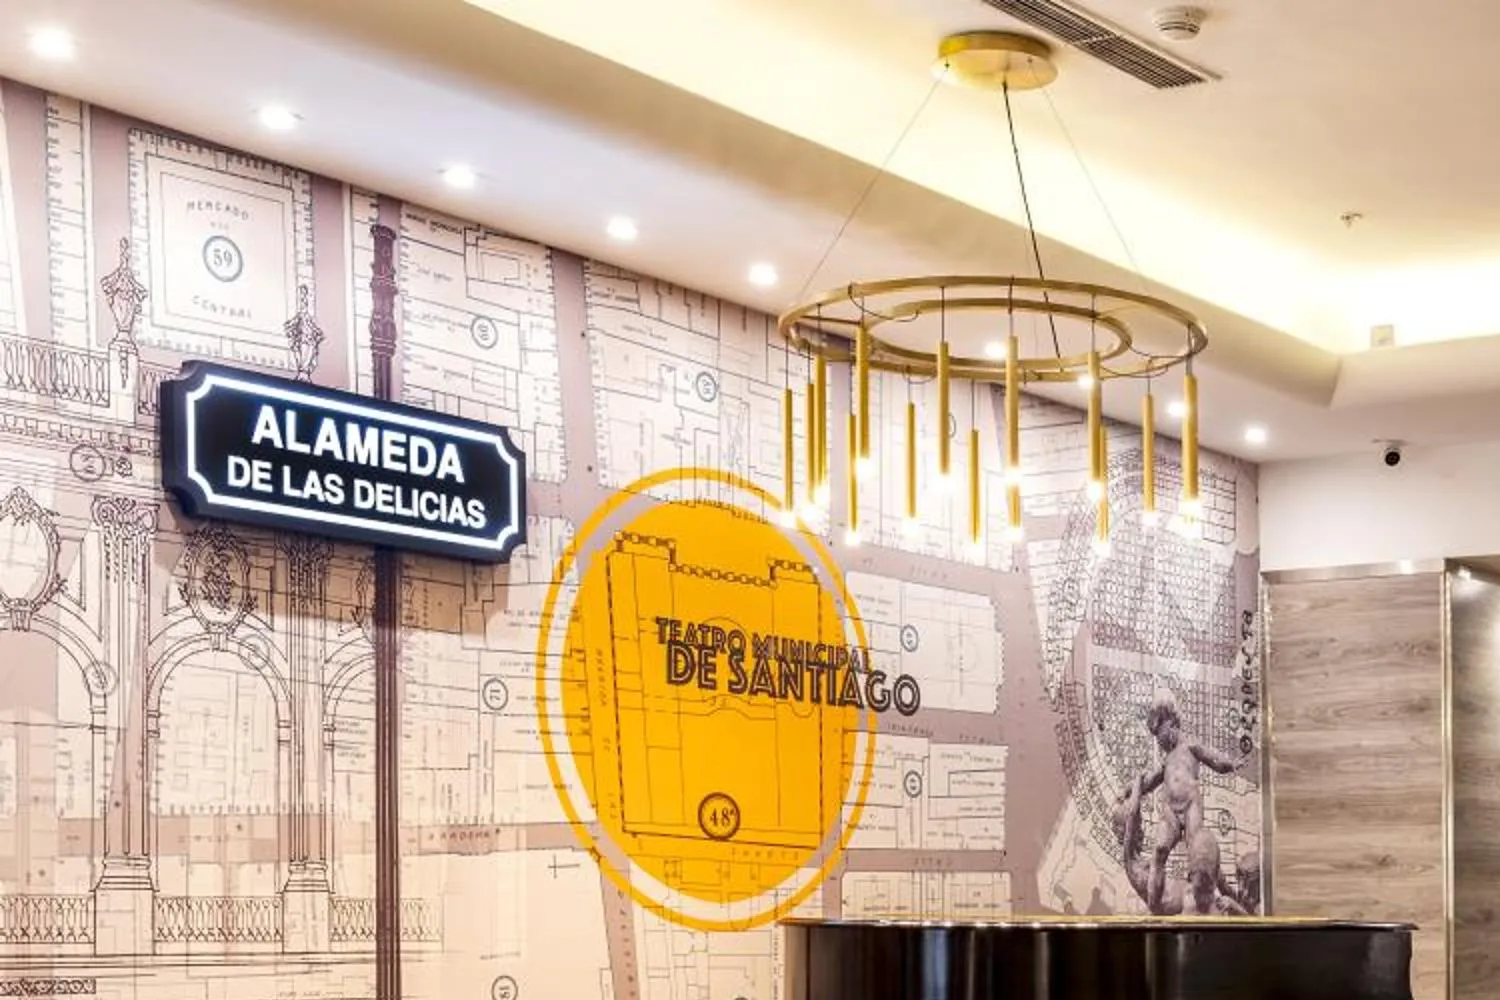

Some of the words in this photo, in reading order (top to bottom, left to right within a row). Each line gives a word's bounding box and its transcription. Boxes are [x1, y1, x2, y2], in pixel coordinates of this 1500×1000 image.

[251, 404, 466, 484] ALAMEDA
[226, 454, 275, 494] DE
[282, 464, 346, 506] LAS
[352, 478, 488, 529] DELICIAS
[655, 616, 748, 656] TEATRO
[751, 632, 873, 674] MUNICIPAL
[666, 639, 718, 691] DE
[727, 651, 922, 717] SANTIAGO
